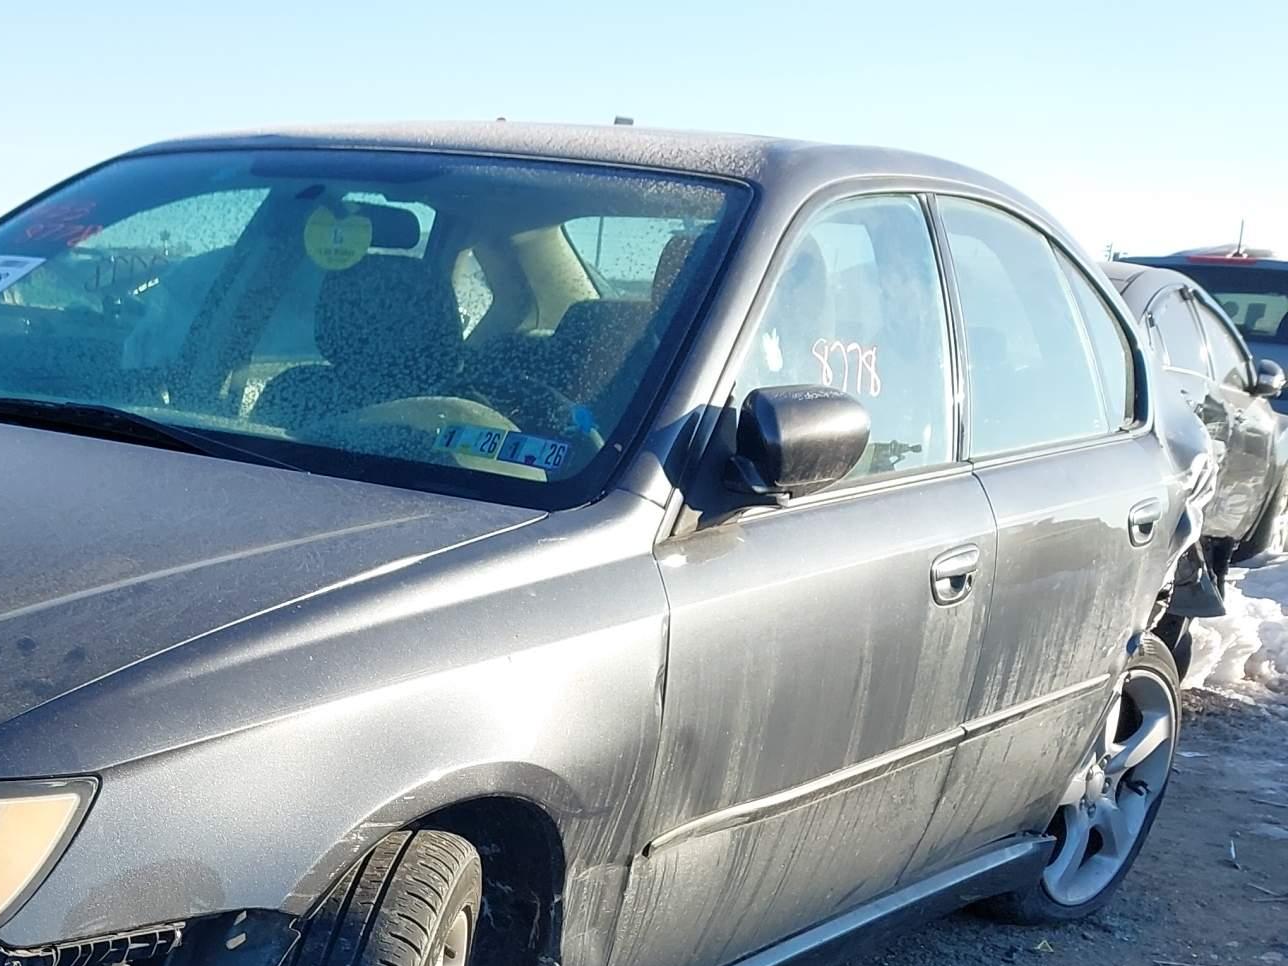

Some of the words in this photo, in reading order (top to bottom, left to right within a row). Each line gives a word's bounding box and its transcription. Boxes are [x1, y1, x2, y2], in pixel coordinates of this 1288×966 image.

[811, 337, 882, 398] 8778
[479, 431, 501, 454] 26
[544, 443, 566, 467] 26
